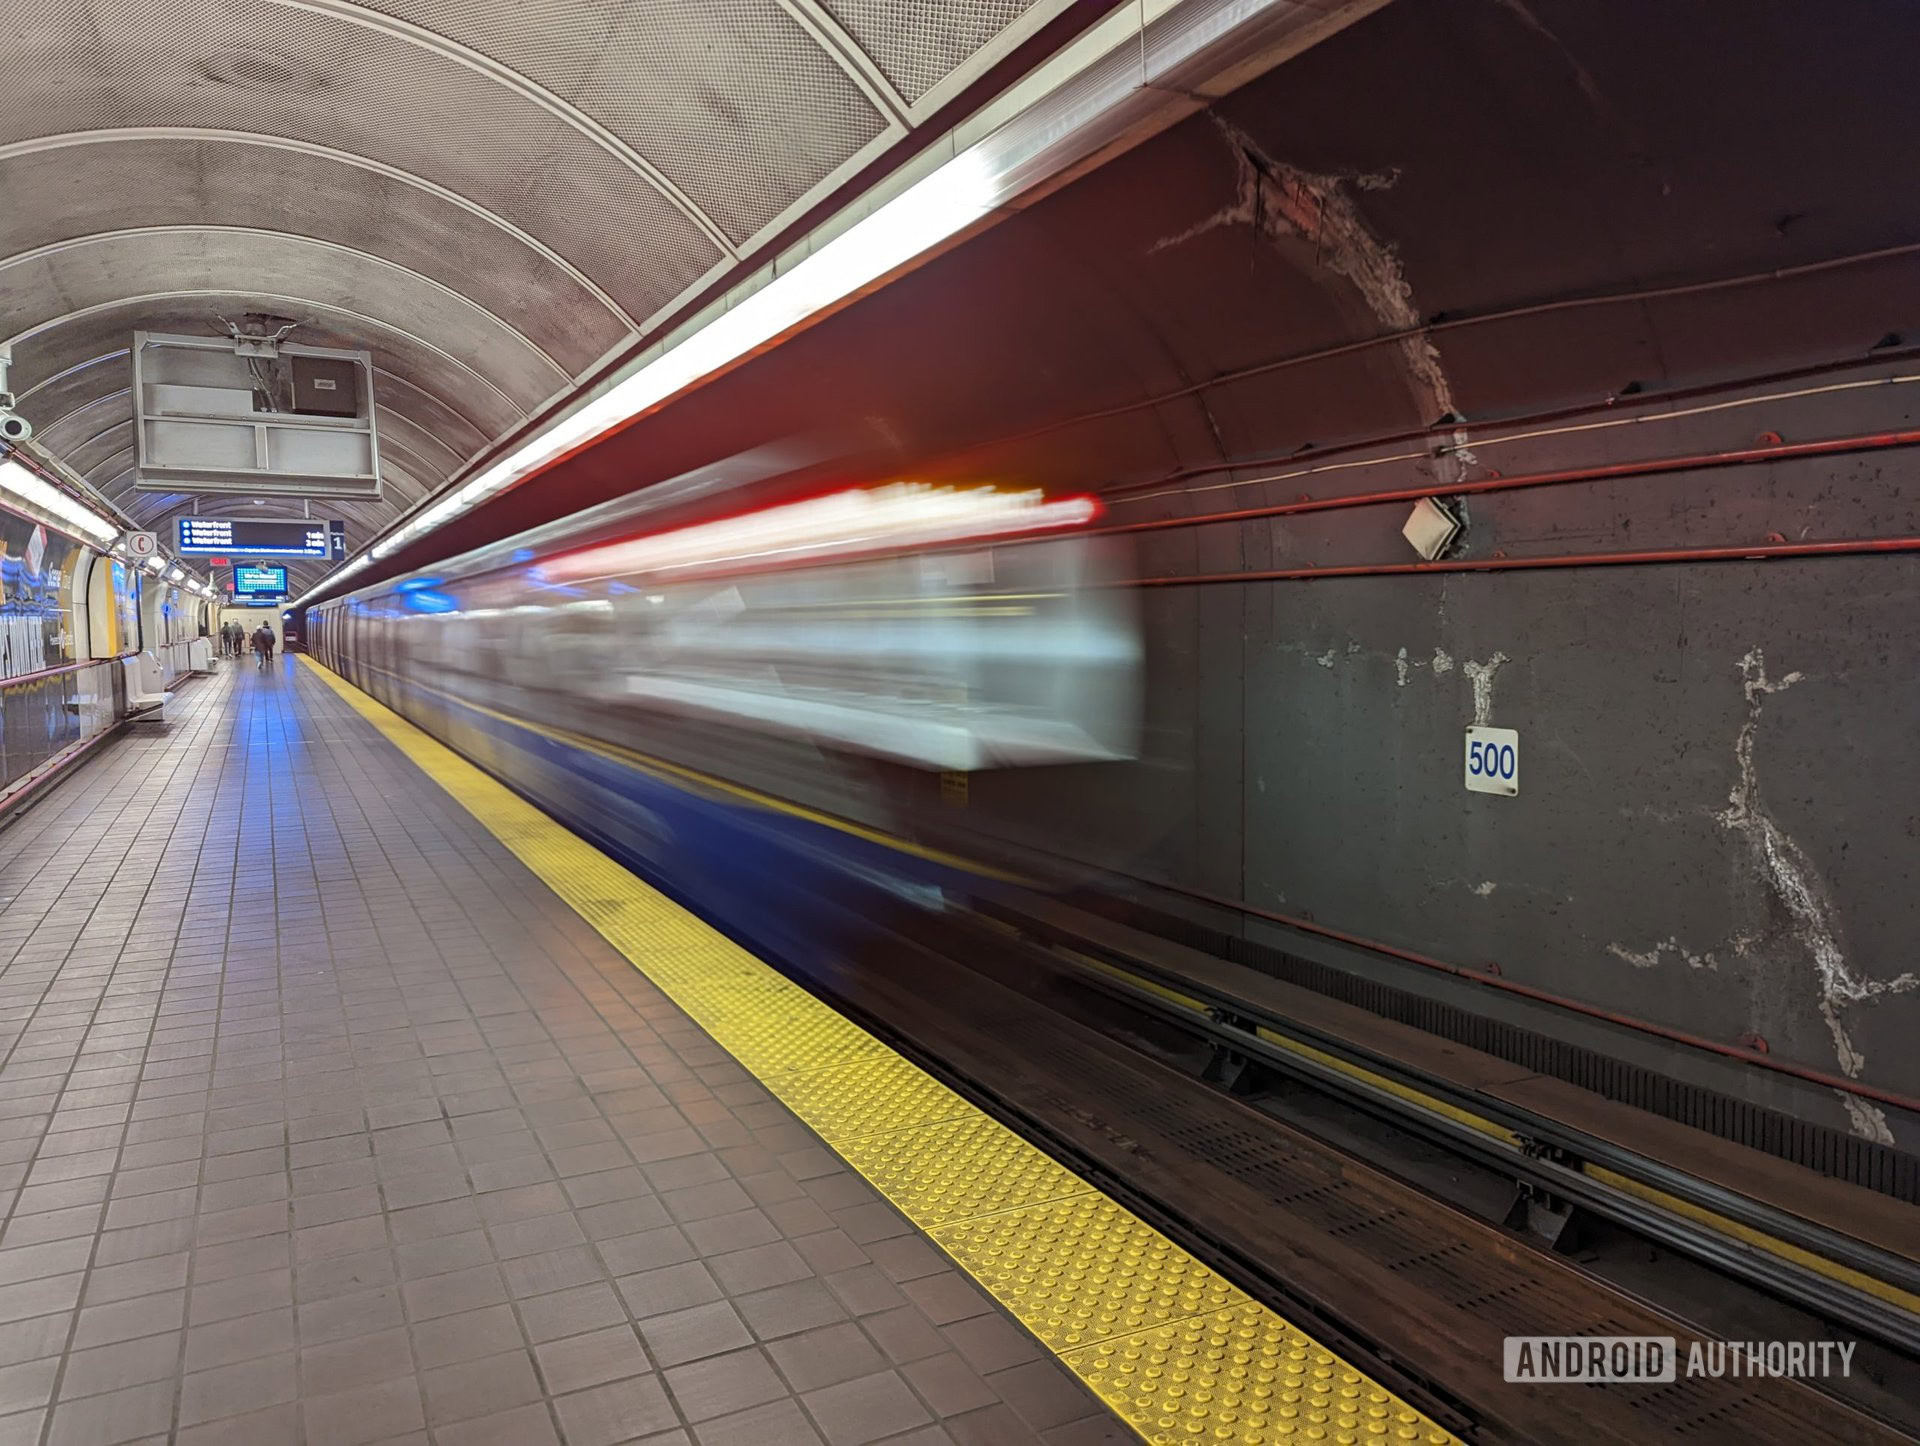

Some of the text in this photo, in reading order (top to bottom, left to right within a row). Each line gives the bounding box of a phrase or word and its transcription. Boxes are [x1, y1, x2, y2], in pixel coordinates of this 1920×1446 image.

[191, 521, 231, 529] Waterfront
[191, 529, 232, 537] Waterfront
[306, 531, 311, 539] 1
[192, 537, 233, 545] Waterfront
[305, 539, 311, 547] 3
[333, 536, 343, 550] 1
[1469, 741, 1515, 780] 500
